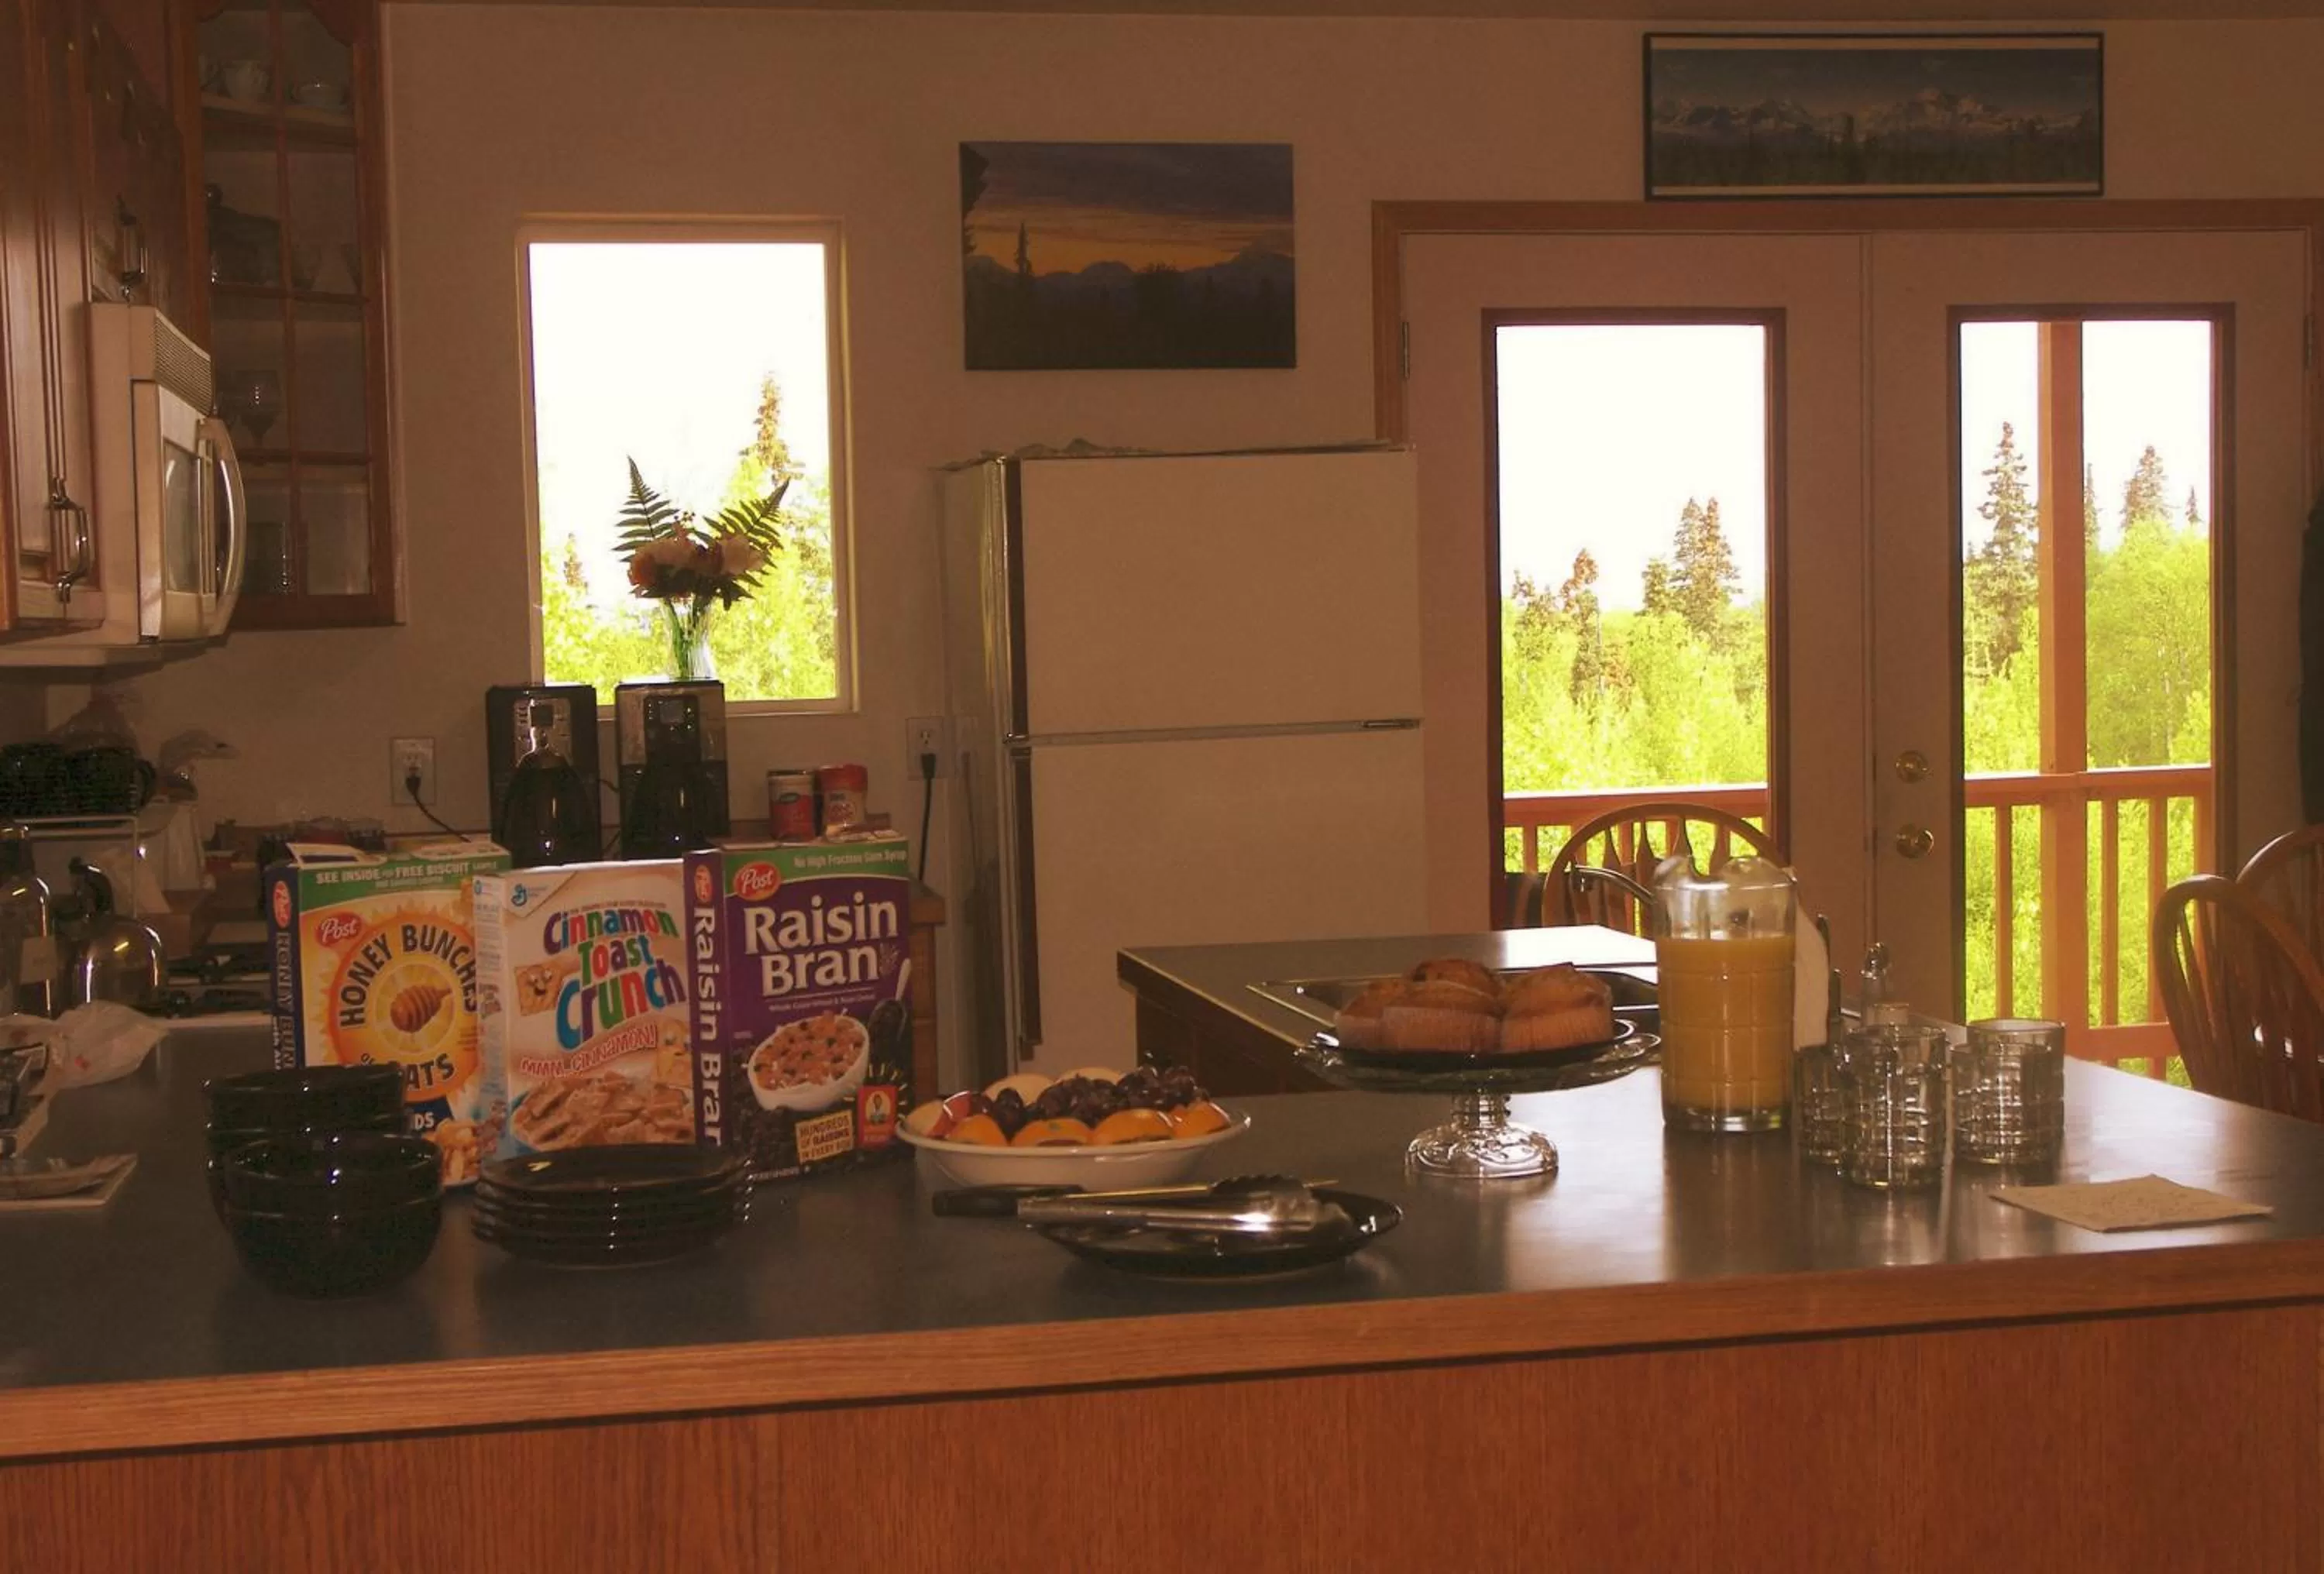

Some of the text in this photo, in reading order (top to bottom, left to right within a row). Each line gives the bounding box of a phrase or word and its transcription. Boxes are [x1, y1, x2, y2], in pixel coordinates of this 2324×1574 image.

[315, 872, 339, 884] SEE
[342, 868, 380, 882] INSIDE
[396, 864, 424, 878] FREE
[427, 861, 469, 875] BISCUIT
[741, 868, 774, 894] Post
[321, 917, 357, 943] Post
[544, 908, 679, 956] Cinnamon
[744, 891, 899, 954] Raisin
[276, 932, 294, 1013] HONEY
[339, 933, 393, 1027] HONEY
[401, 923, 477, 1012] BUNCHES
[578, 934, 654, 987] Toast
[694, 907, 722, 1040] Raisin
[760, 945, 879, 997] Bran
[556, 957, 687, 1051] Crunch
[388, 1053, 455, 1089] ATS
